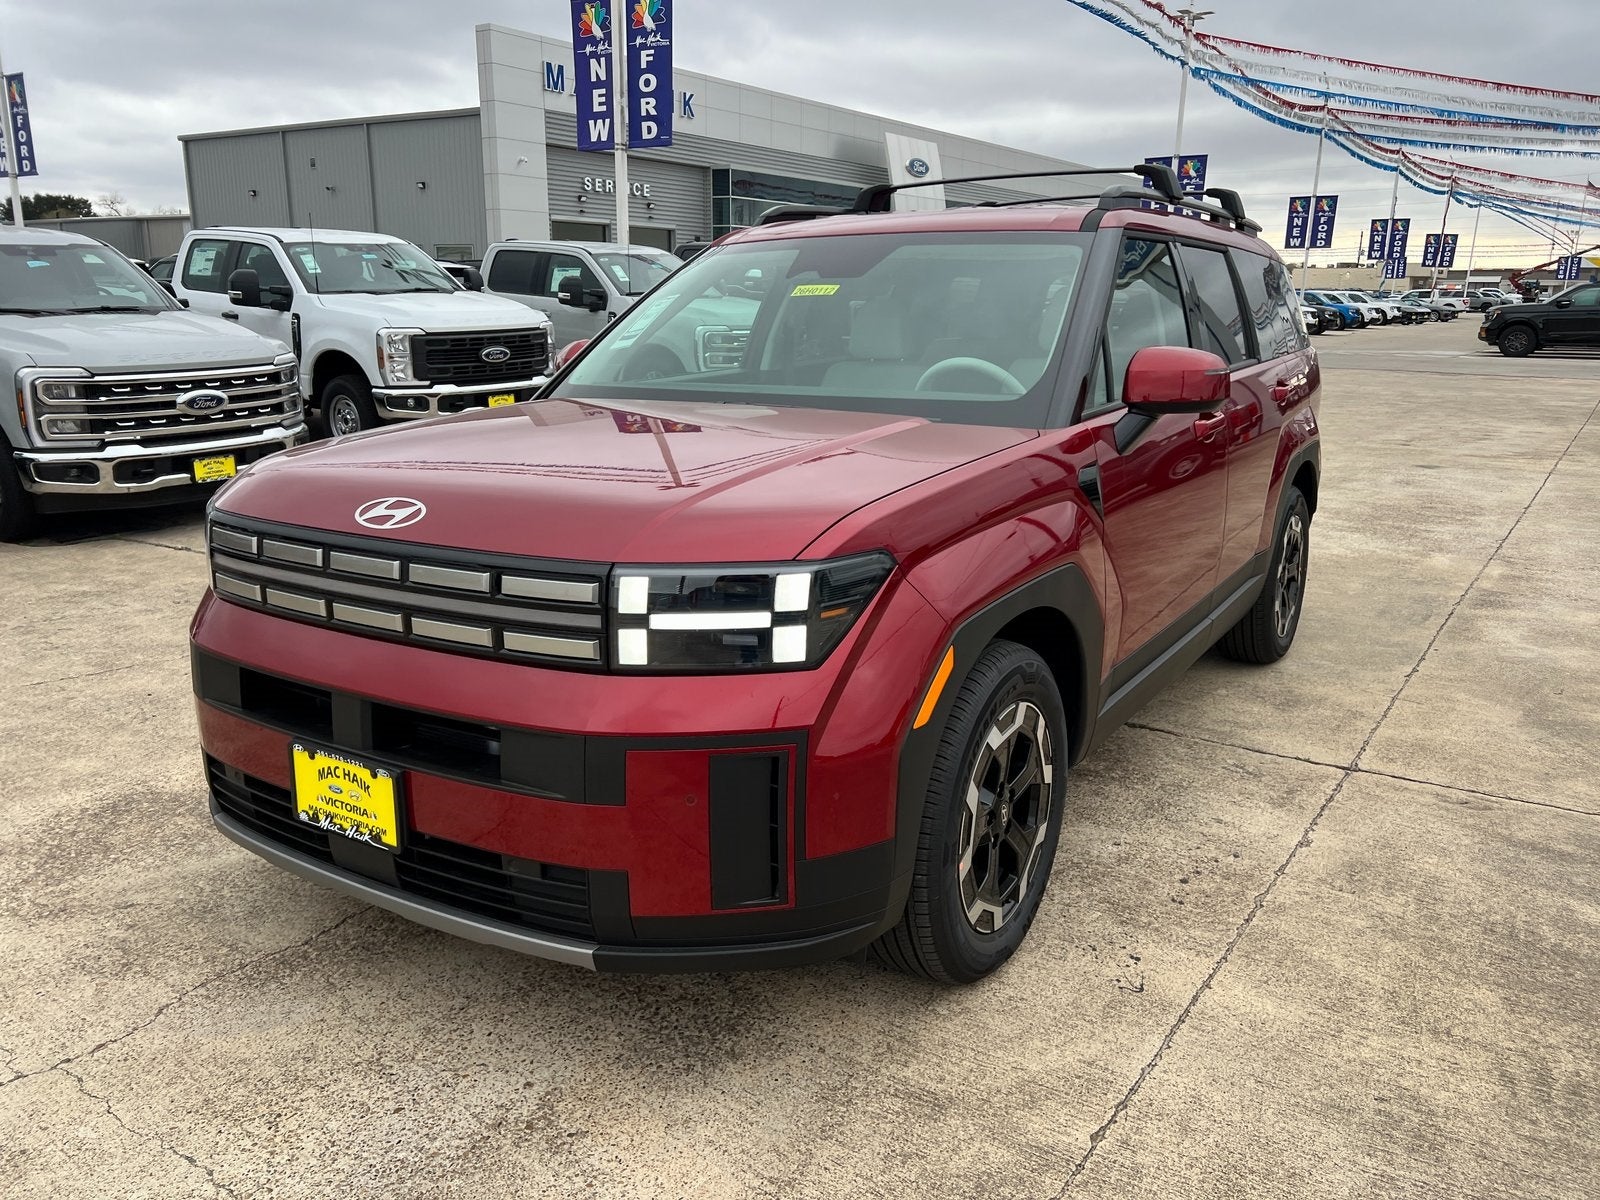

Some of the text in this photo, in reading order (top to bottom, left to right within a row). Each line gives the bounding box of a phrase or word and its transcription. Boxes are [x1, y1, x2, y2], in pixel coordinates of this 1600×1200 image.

[588, 57, 610, 142] NEW
[638, 50, 658, 140] FORD
[16, 115, 31, 172] FORD
[584, 176, 651, 197] SERICE
[1290, 217, 1302, 247] NEW
[1316, 216, 1328, 247] FORD
[1371, 235, 1382, 258] NEW
[1392, 234, 1402, 258] FORD
[1425, 247, 1435, 266] NEW
[1442, 247, 1451, 266] FORD
[1557, 265, 1566, 279] NEW
[193, 396, 217, 409] Ford
[318, 766, 372, 798] MAC HAIK
[324, 795, 370, 819] VICTORIA
[319, 815, 345, 835] Mac
